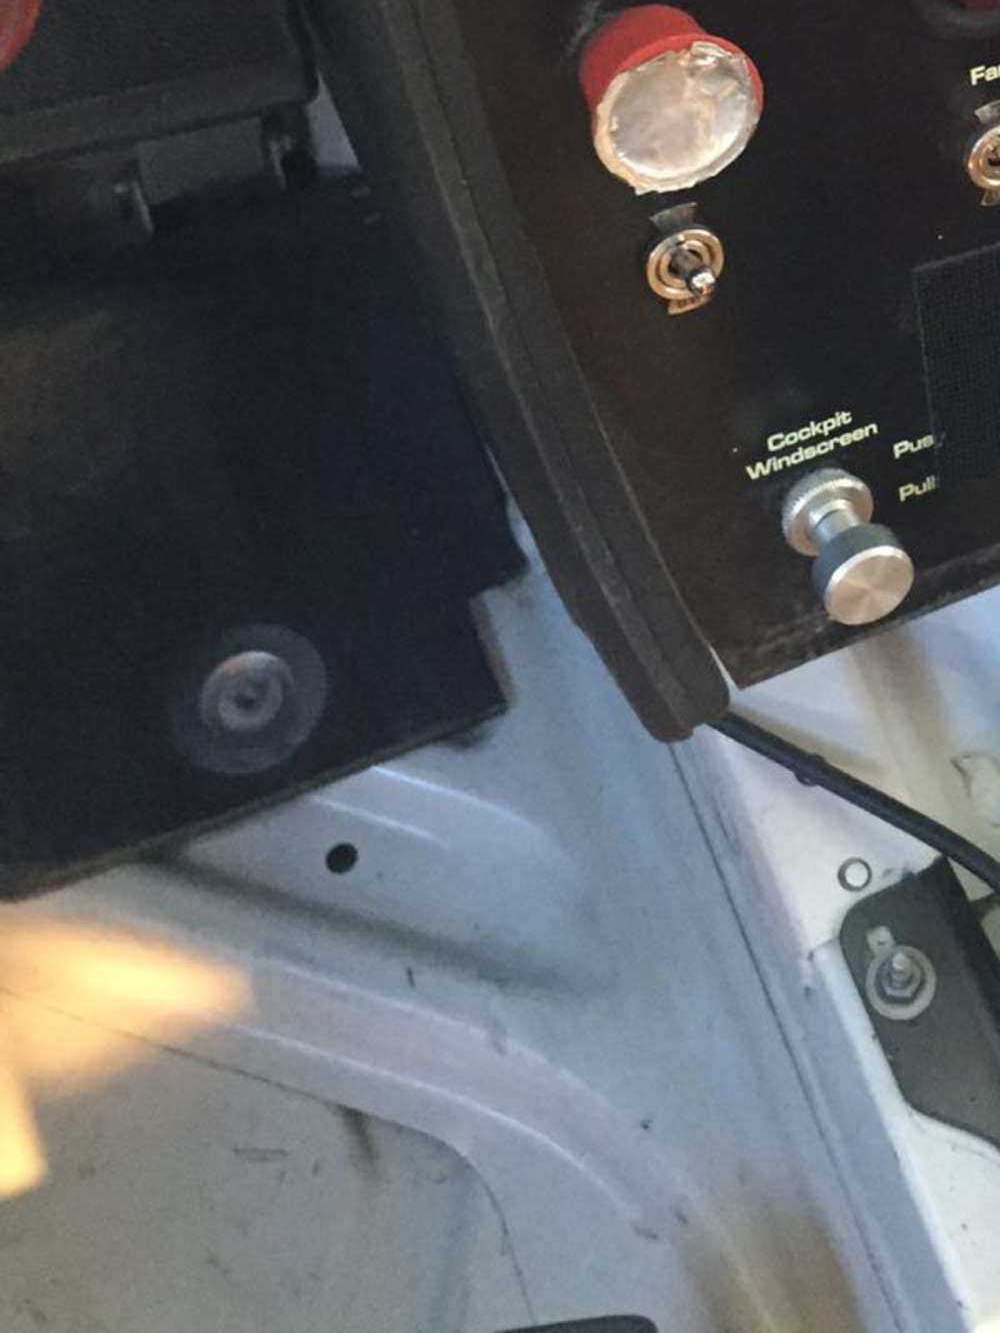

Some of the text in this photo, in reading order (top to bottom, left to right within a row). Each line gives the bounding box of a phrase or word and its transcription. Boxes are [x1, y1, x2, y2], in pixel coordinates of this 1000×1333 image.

[745, 423, 878, 480] Windscreen
[767, 411, 853, 452] Cockpit
[892, 434, 935, 459] Pus
